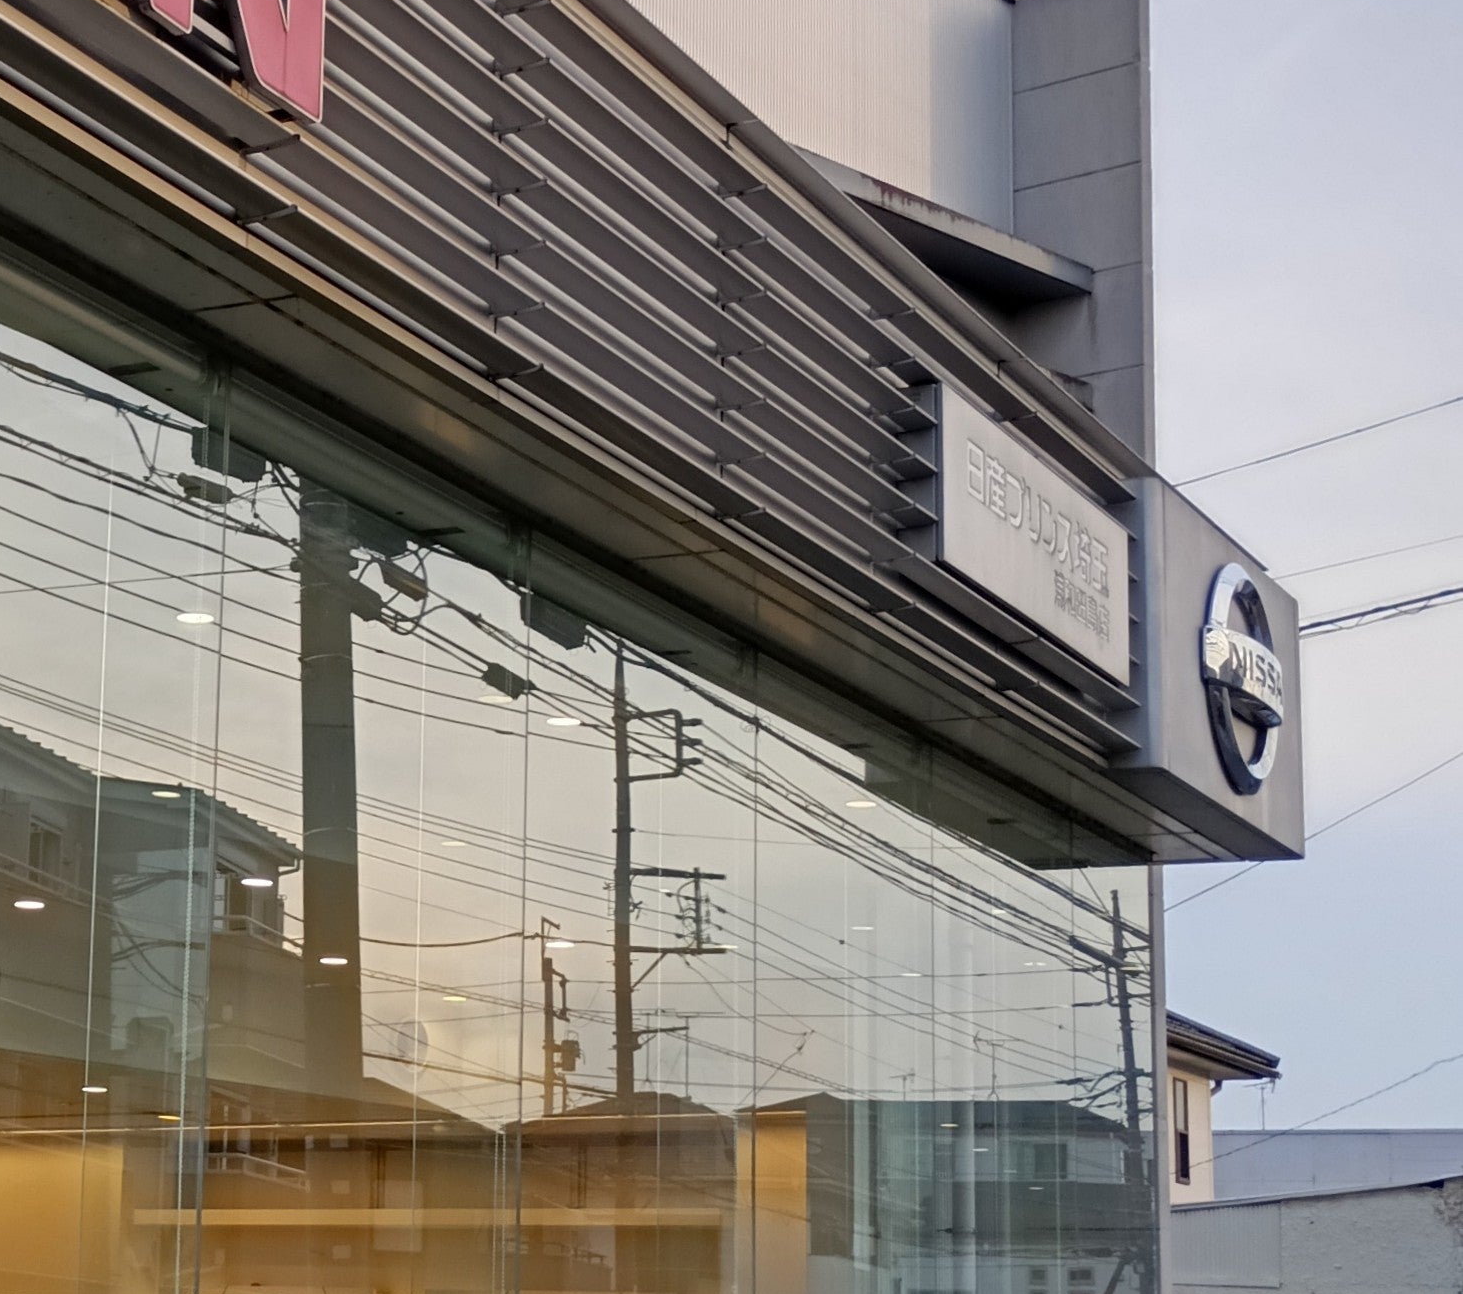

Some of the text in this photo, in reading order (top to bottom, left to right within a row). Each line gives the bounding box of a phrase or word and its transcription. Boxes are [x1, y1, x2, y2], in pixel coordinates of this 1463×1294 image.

[966, 437, 1110, 599] 日産プリンス埼玉
